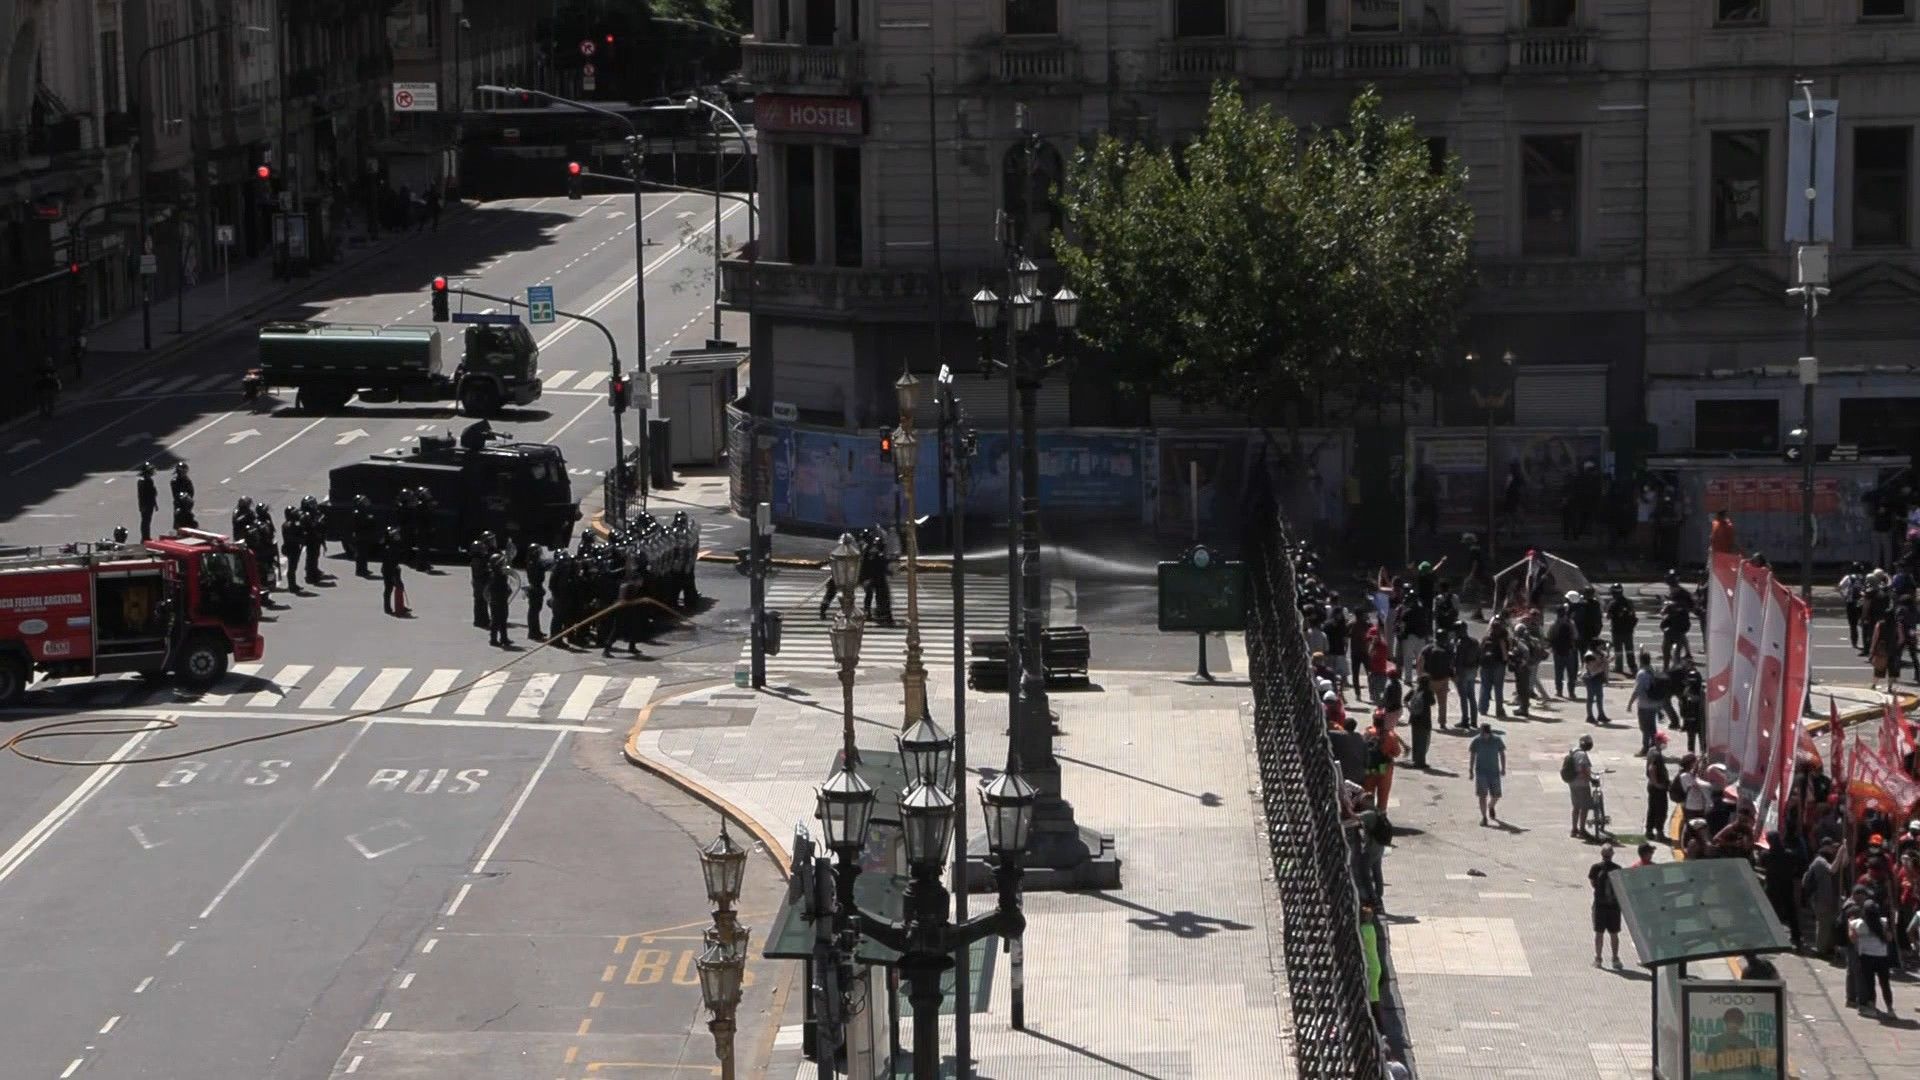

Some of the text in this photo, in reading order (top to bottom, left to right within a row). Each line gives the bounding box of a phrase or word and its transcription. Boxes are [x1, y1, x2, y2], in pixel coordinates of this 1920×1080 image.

[789, 106, 855, 126] HOSTEL
[15, 597, 42, 607] FEDERAL
[44, 594, 82, 605] ARGENTINA
[366, 768, 490, 793] BUS
